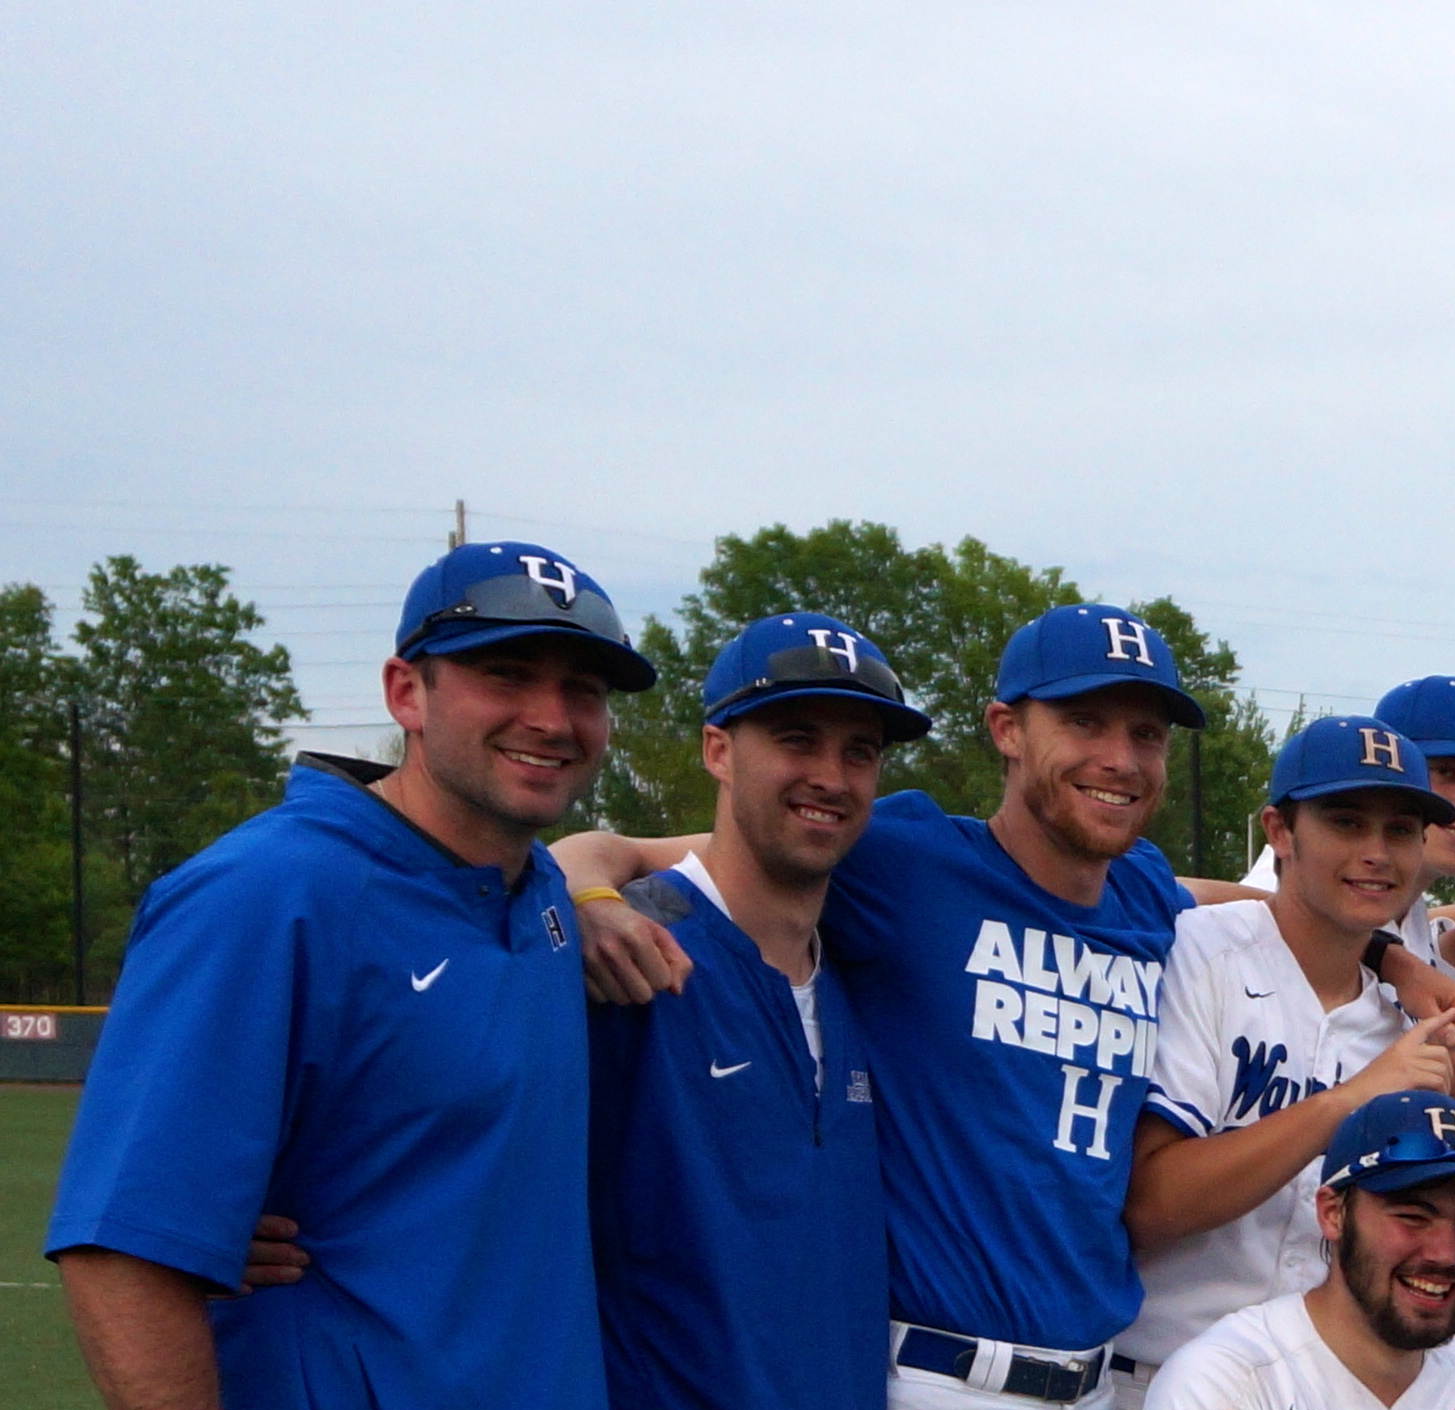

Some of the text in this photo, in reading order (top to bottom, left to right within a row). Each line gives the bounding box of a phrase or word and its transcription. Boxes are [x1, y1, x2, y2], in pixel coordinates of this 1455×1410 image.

[519, 556, 577, 606] H
[807, 629, 859, 672] H
[1102, 617, 1155, 667] H
[1358, 728, 1404, 772] H
[541, 905, 567, 952] H
[966, 919, 1161, 1018] ALWAY
[7, 1015, 51, 1037] 370
[1054, 1064, 1123, 1160] H
